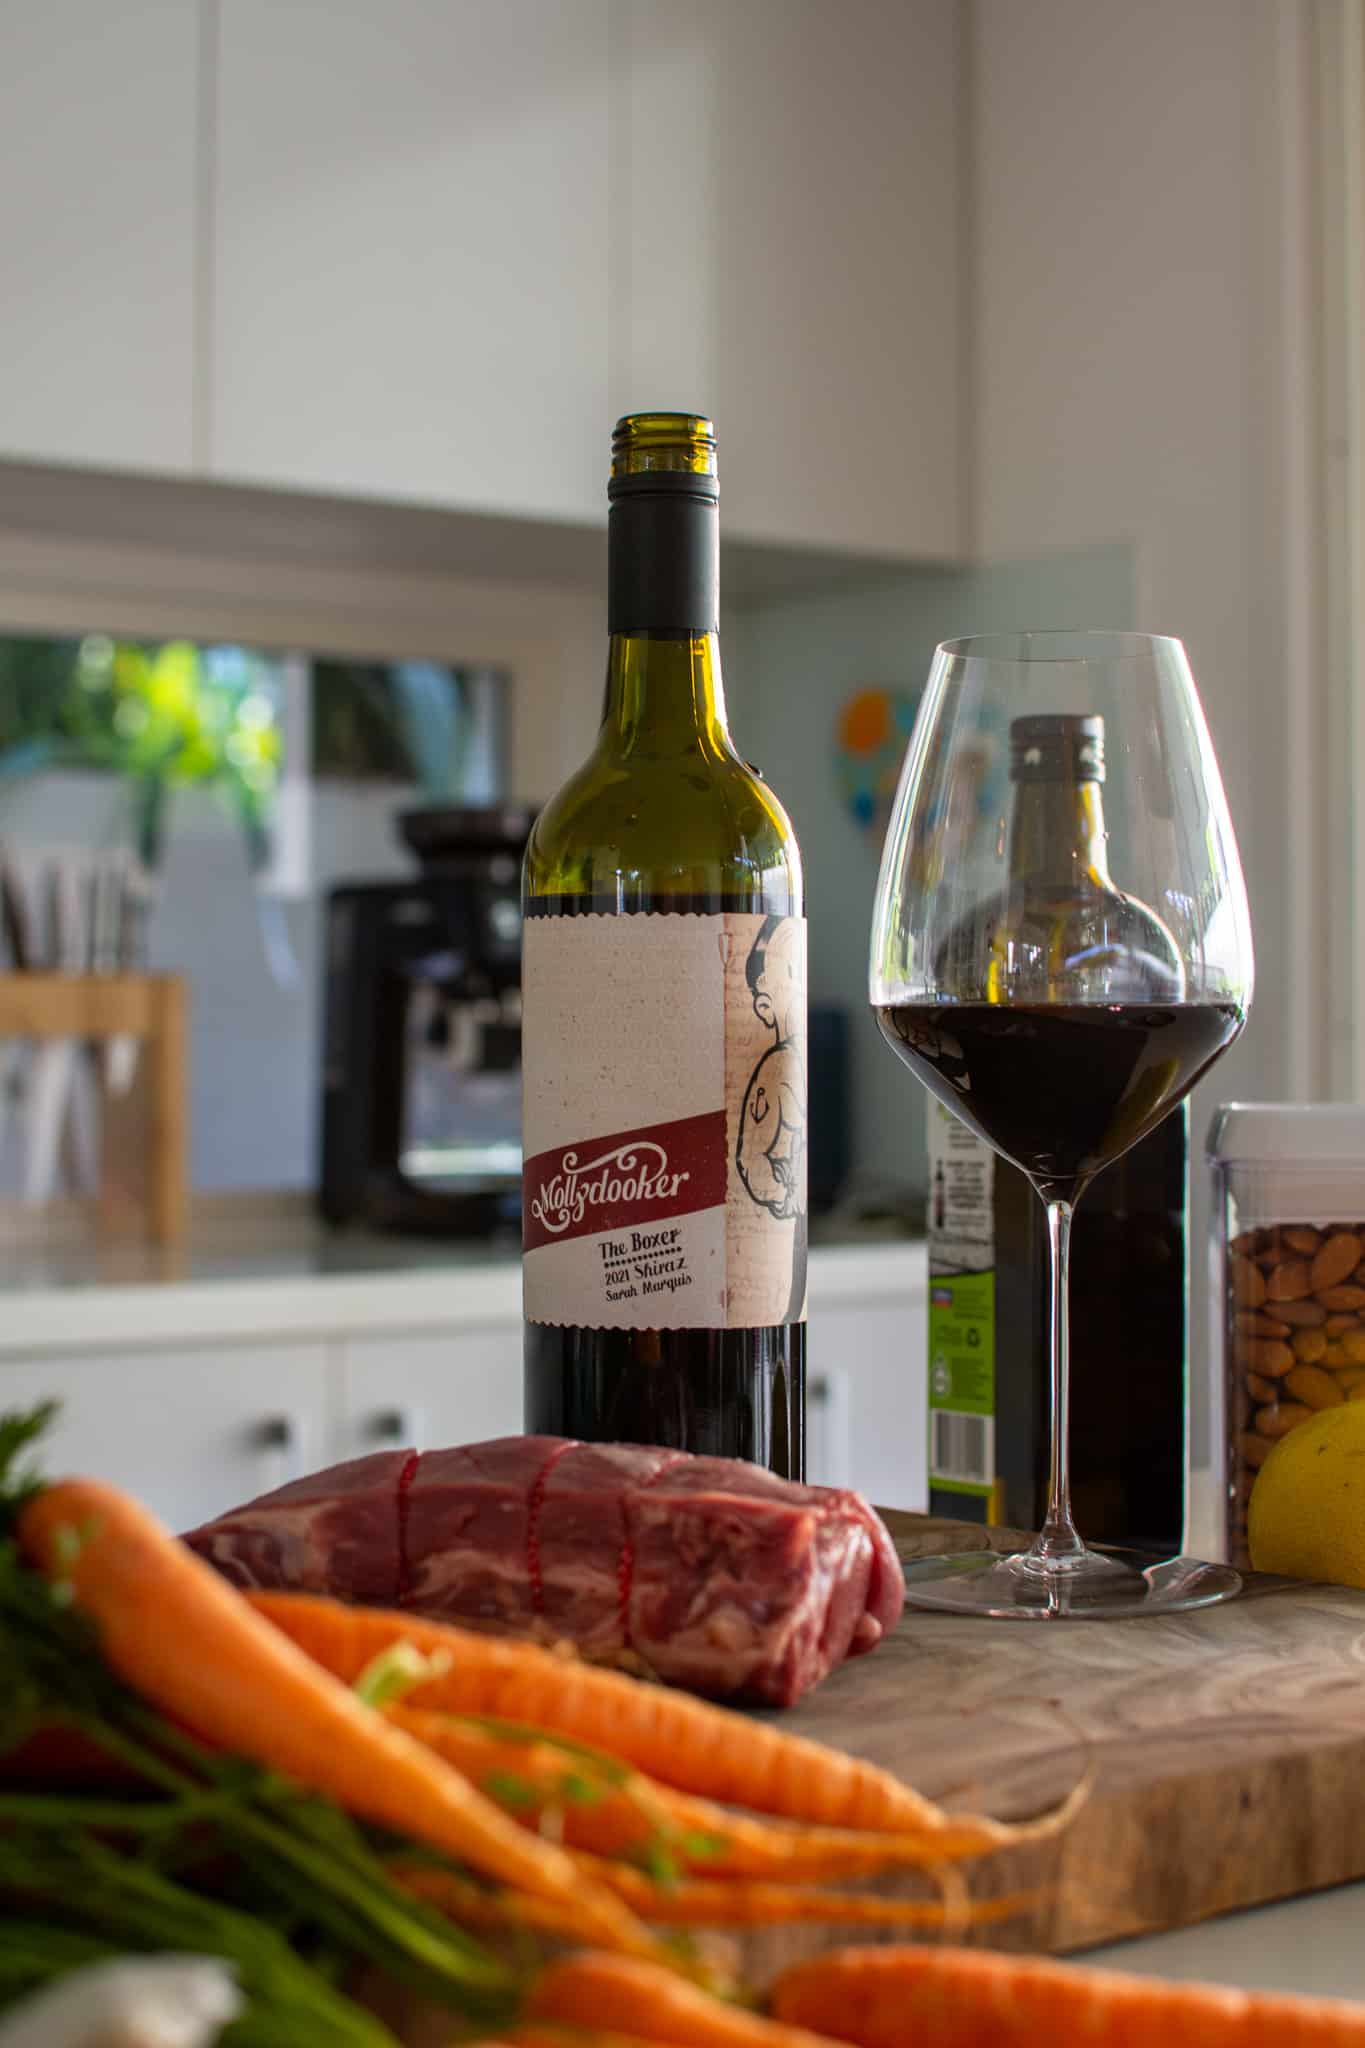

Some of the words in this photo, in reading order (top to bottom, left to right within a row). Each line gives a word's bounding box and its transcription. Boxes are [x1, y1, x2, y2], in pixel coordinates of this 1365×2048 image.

[531, 1141, 690, 1233] Mollydooker
[598, 1241, 628, 1260] The
[630, 1227, 682, 1252] Boxer
[605, 1269, 630, 1286] 2021
[634, 1257, 688, 1279] Shiraz
[605, 1284, 638, 1302] Sarah
[642, 1272, 692, 1294] Marquis
